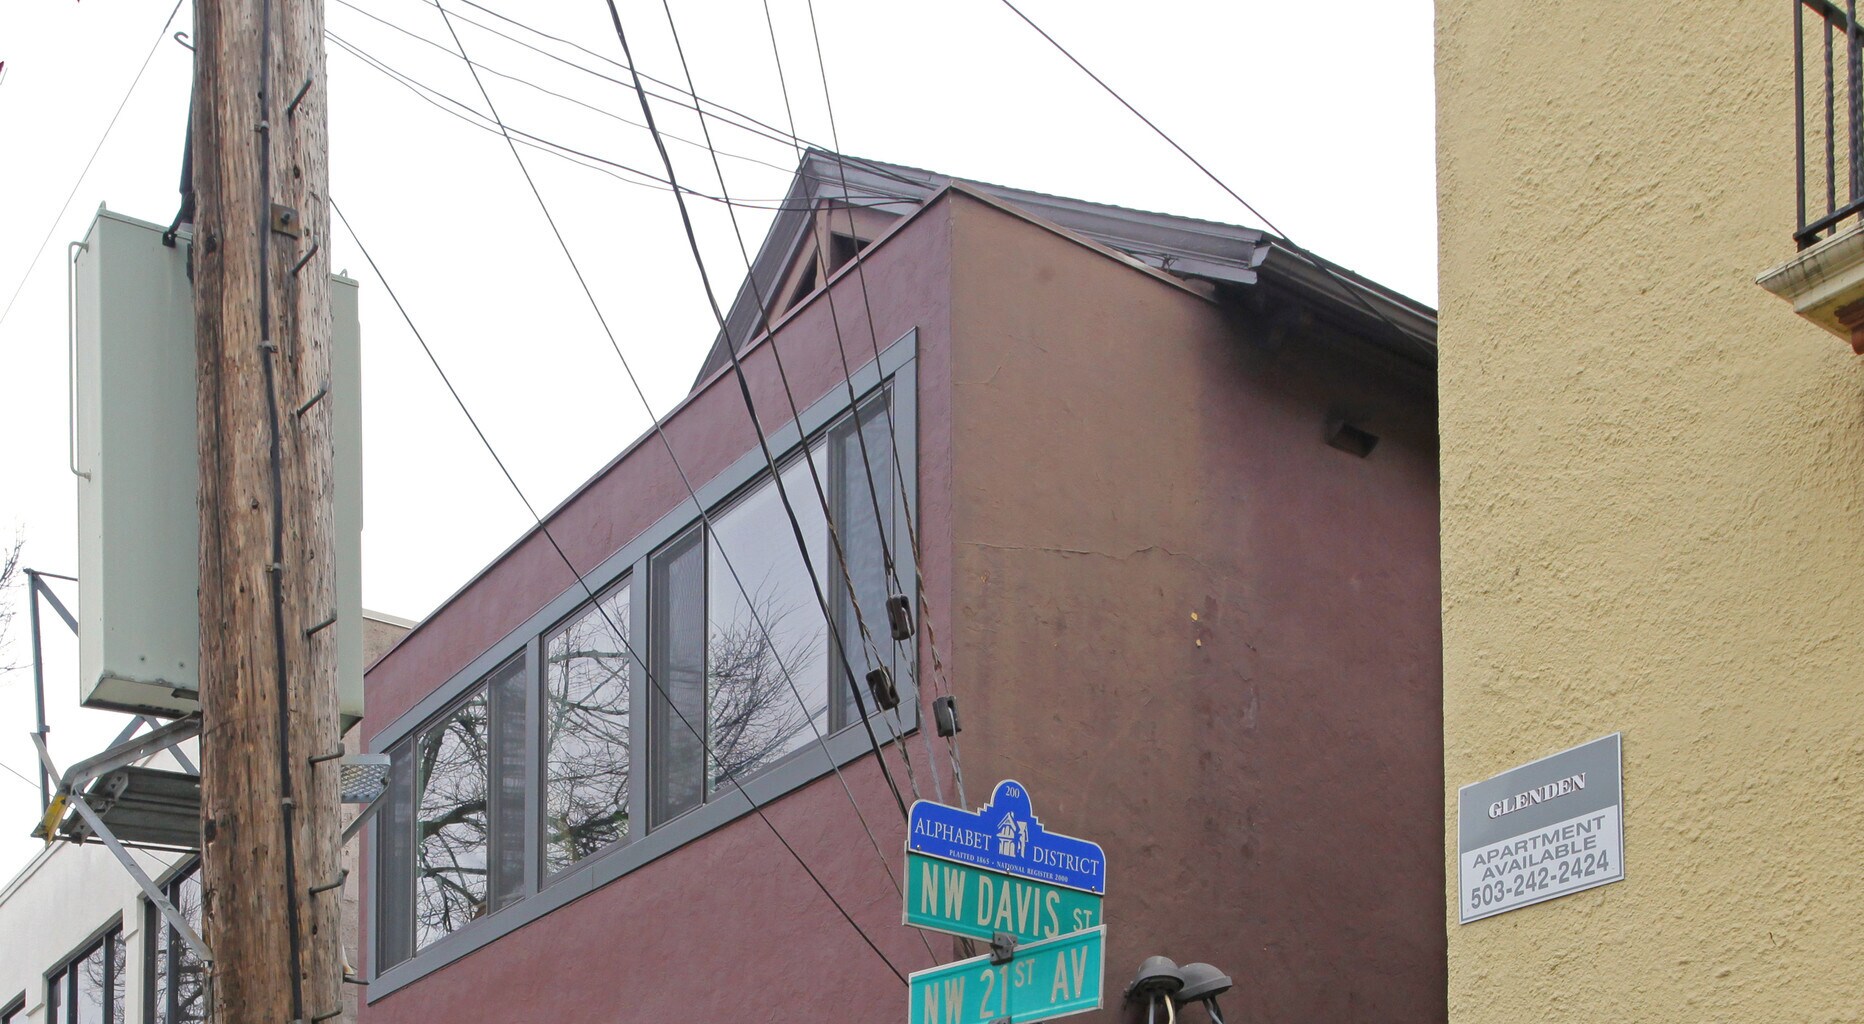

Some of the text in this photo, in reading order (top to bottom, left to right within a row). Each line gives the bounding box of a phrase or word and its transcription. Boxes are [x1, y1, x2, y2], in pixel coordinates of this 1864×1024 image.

[1005, 785, 1020, 799] 200
[1488, 772, 1587, 820] GLENDEN
[914, 817, 1100, 876] ALPHABET DISTRICT
[949, 849, 975, 862] PLATTED
[996, 861, 1025, 874] NATIONAL
[1027, 868, 1053, 880] REGISTER
[1055, 873, 1069, 883] 2000
[1472, 815, 1606, 869] APARTMENT
[1481, 834, 1597, 882] AVAILABLE
[921, 862, 1093, 938] NW DAVIS ST
[1471, 849, 1609, 910] 503-242-2424
[1051, 945, 1088, 1003] AV
